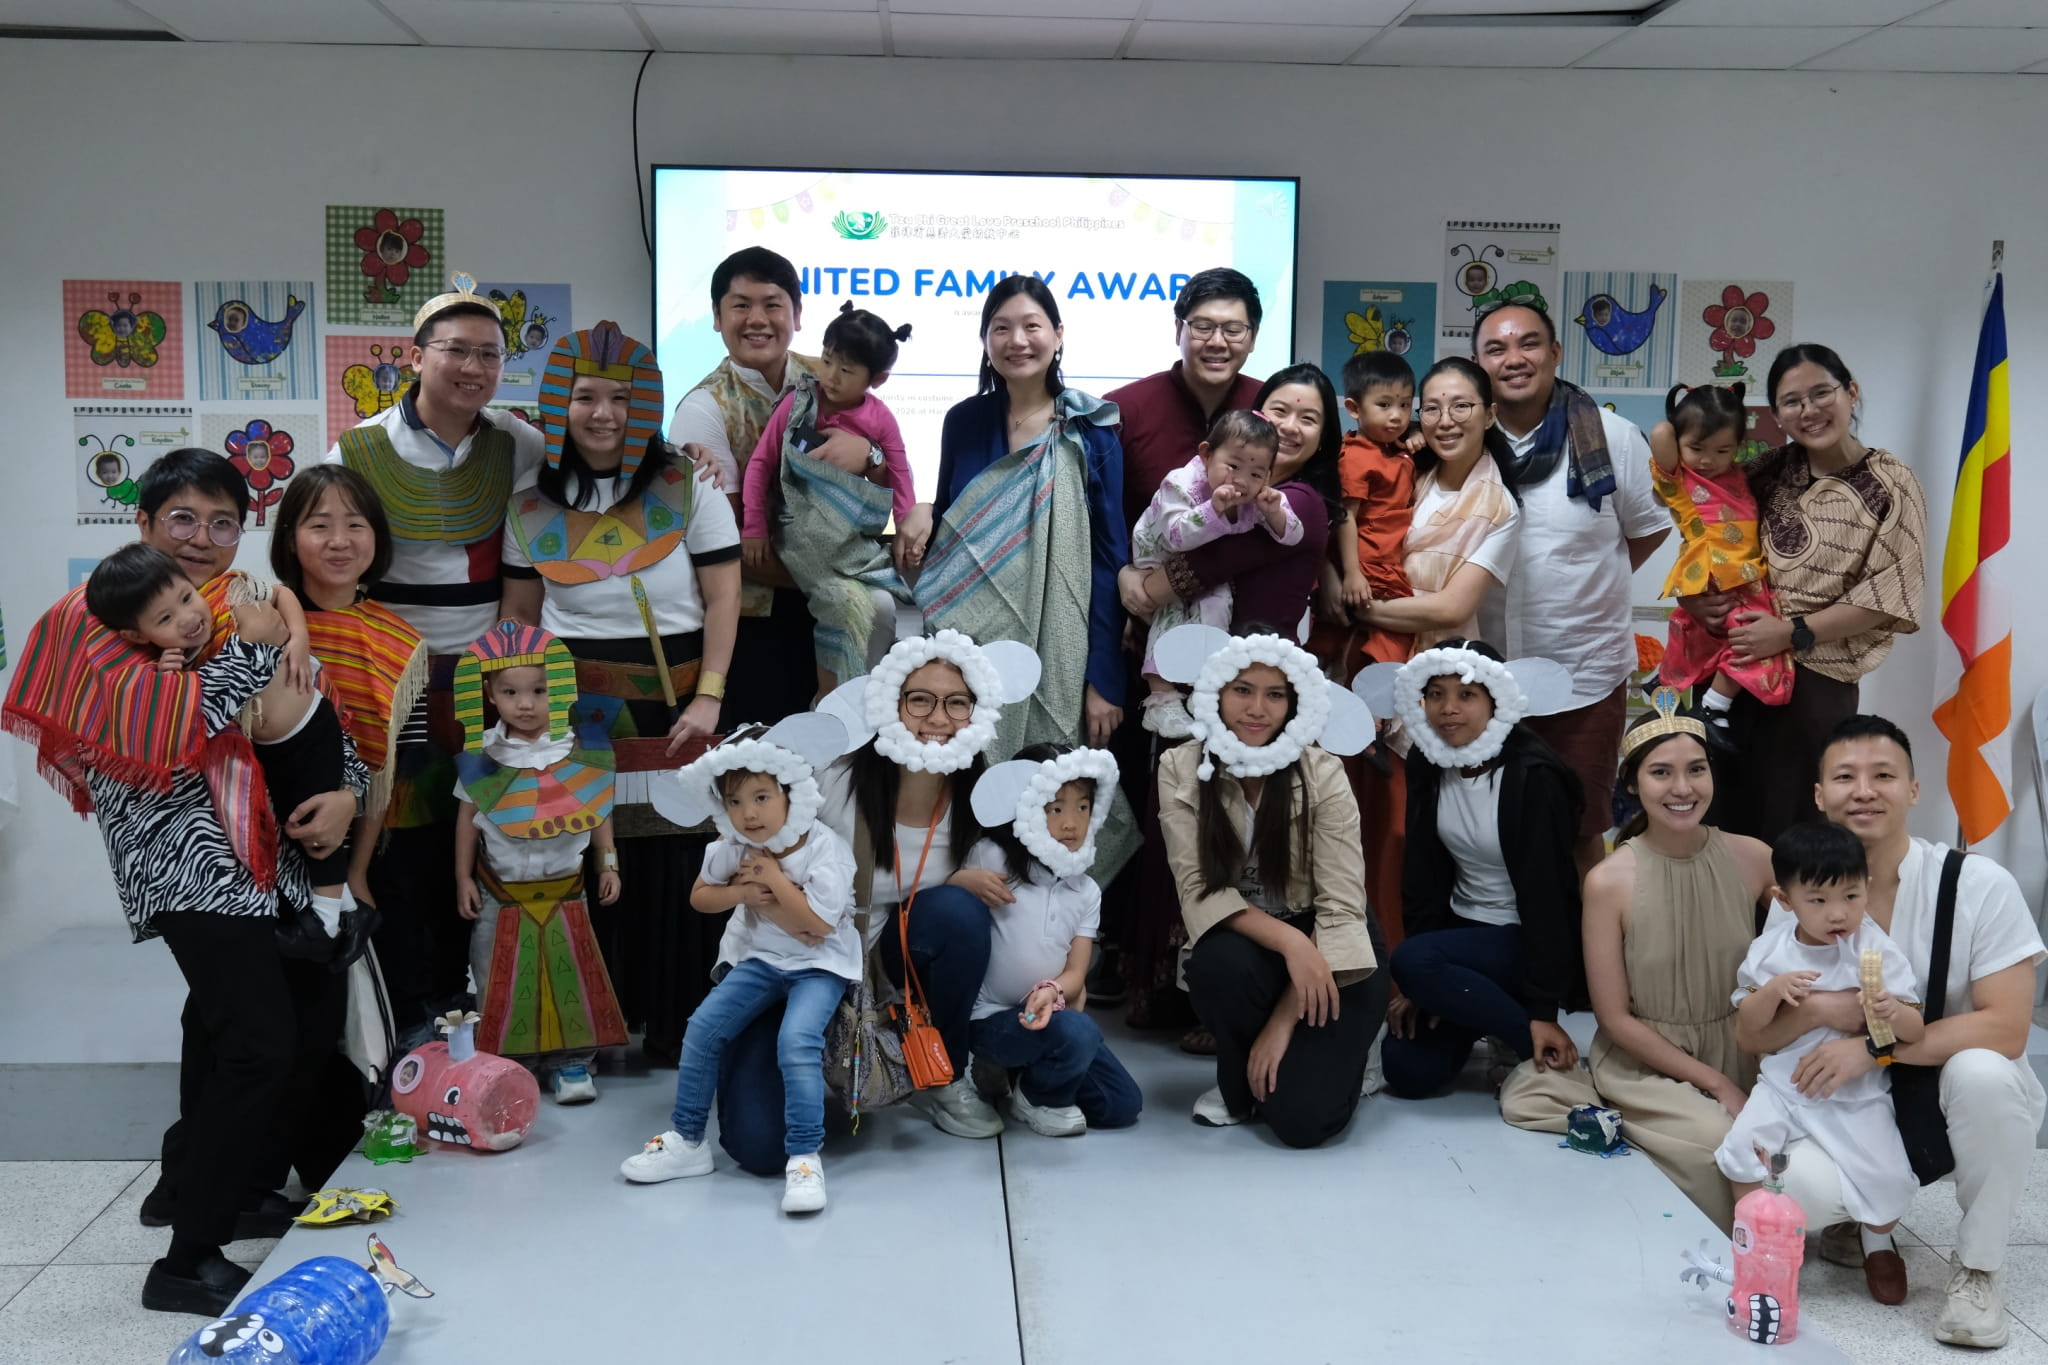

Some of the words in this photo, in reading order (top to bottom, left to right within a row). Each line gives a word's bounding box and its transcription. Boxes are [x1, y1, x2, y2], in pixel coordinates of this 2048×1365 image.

[971, 215, 1001, 227] Love
[800, 266, 900, 296] NITED
[1067, 271, 1191, 301] AWAR
